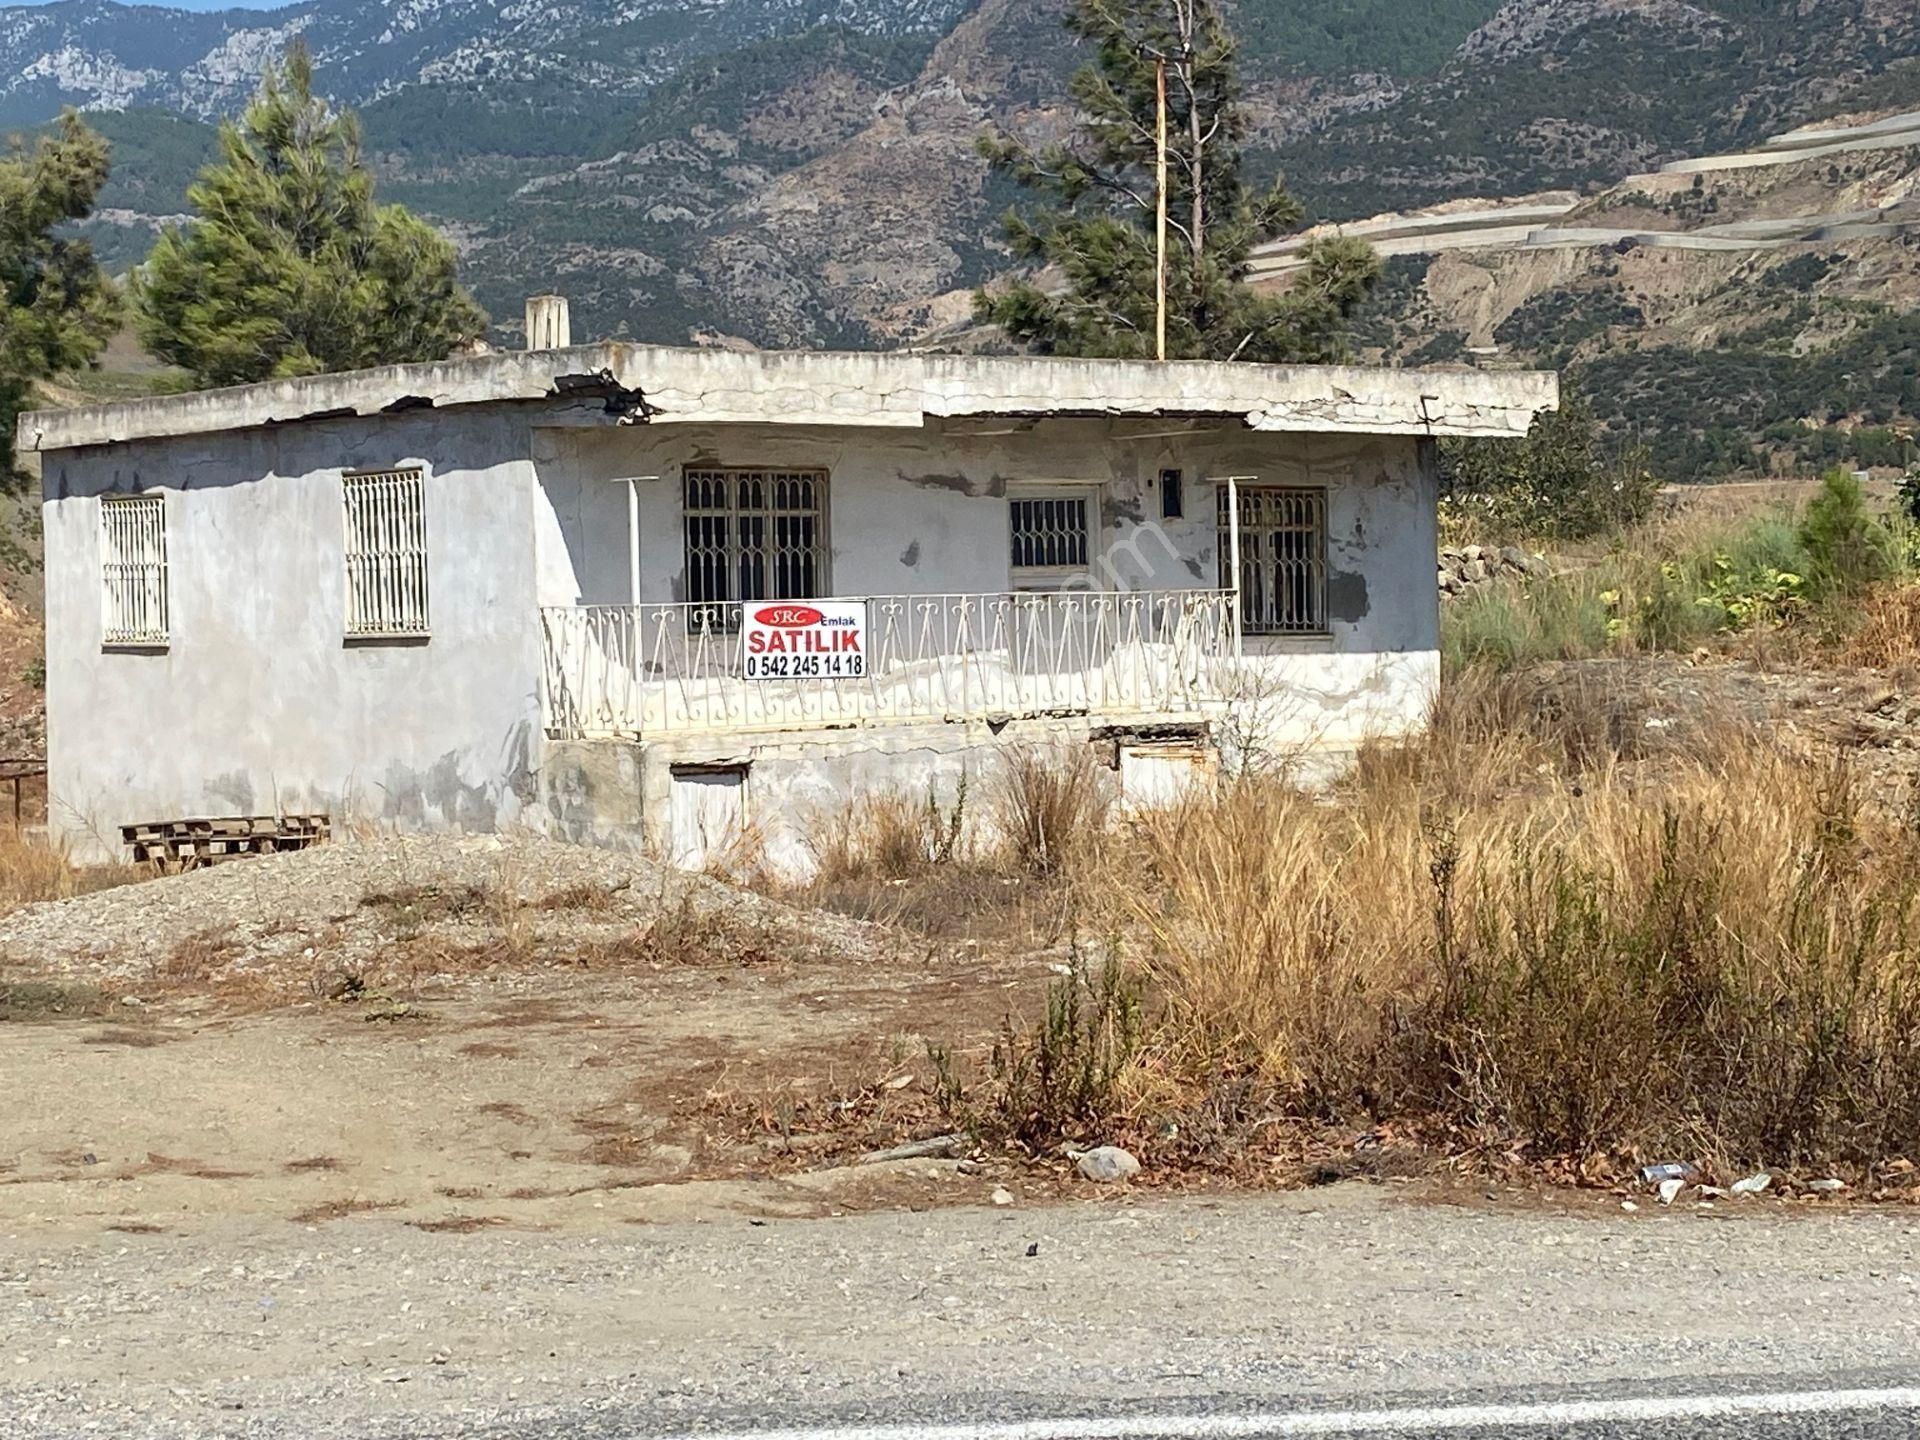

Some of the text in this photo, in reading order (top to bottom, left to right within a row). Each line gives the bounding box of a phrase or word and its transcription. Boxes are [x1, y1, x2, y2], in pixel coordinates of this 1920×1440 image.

[769, 609, 856, 627] SRC Emlak
[748, 630, 861, 654] SATILIK
[747, 654, 862, 677] 0 542 245 14 18
